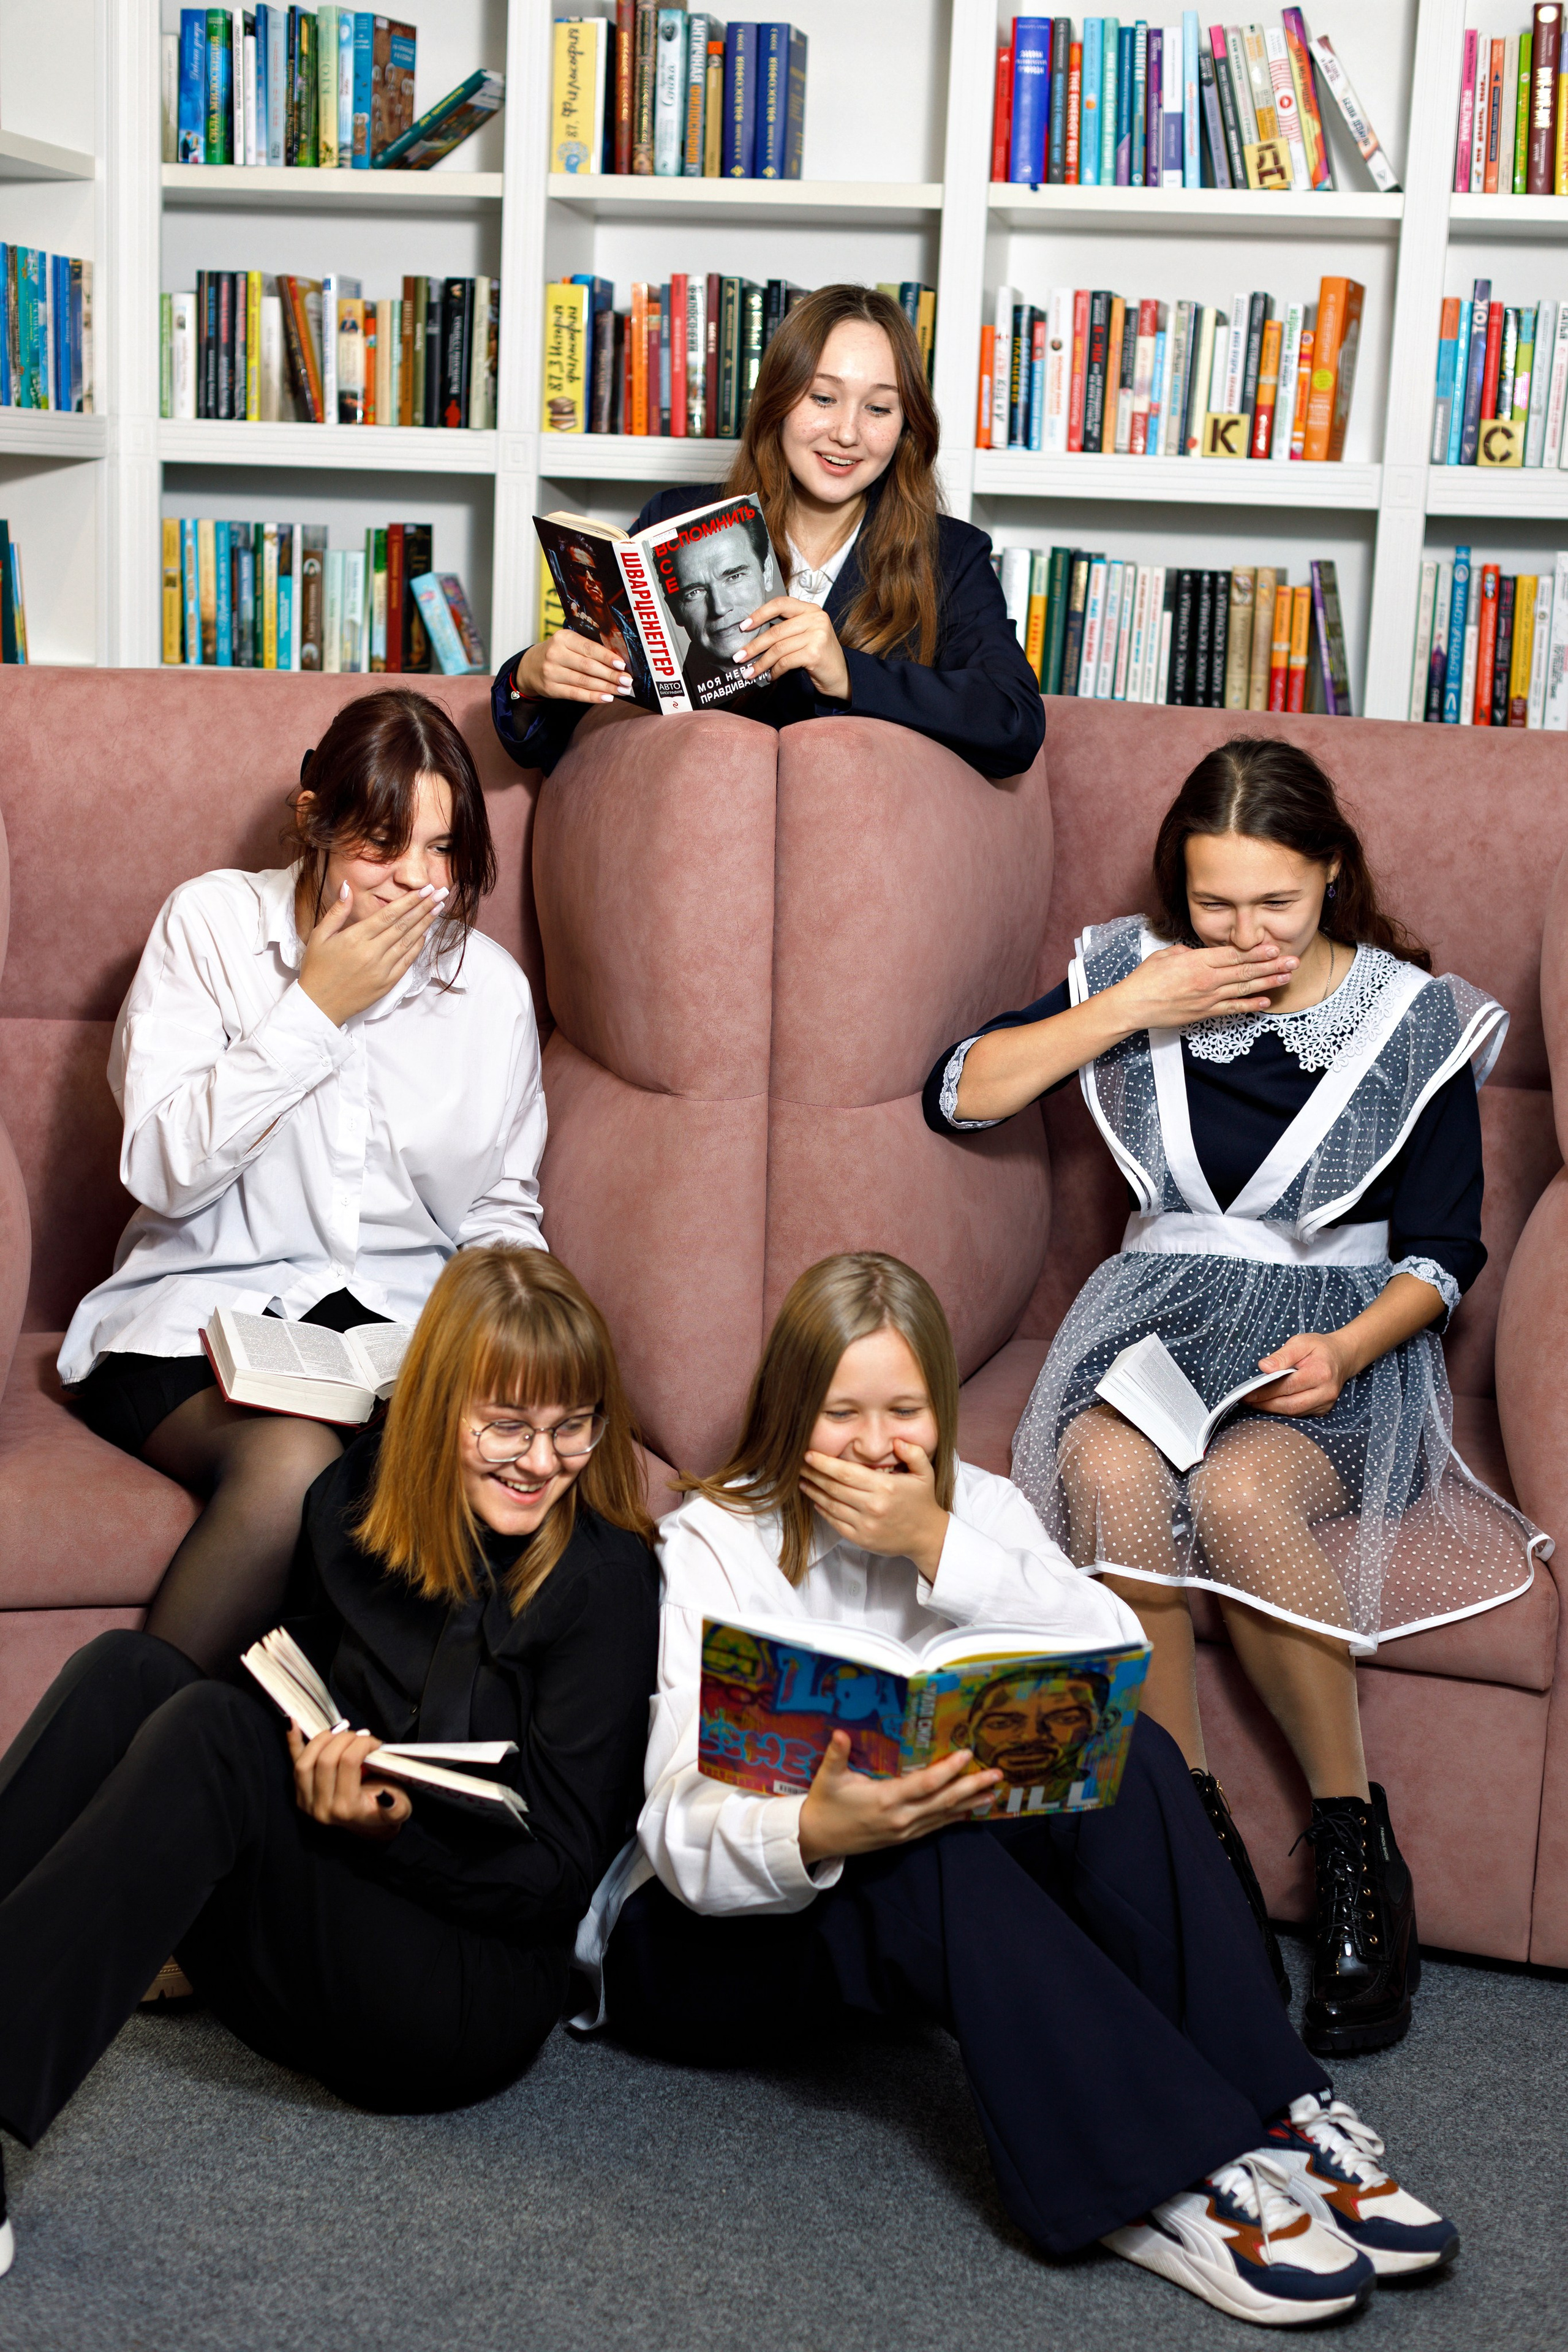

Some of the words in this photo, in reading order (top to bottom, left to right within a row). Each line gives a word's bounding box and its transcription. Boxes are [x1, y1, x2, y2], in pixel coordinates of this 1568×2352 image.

[689, 18, 706, 83] АНТИЧНАЯ
[734, 56, 745, 122] ФИЛОСОФИЯ
[766, 57, 778, 123] ФИЛОСОФИЯ
[1067, 70, 1080, 92] THE
[209, 113, 219, 143] СИЛА
[685, 85, 702, 163] ФИЛОСОФИЯ
[1067, 93, 1079, 138] ENERGY
[1067, 140, 1078, 164] BUS
[1472, 298, 1488, 336] ТОК
[1011, 337, 1022, 404] ПЛАЦЕБО
[1210, 418, 1241, 454] К
[1483, 426, 1513, 463] С
[654, 505, 755, 558] ВСПОМНИТЬ
[620, 552, 674, 676] ШВАРЦЕНЕГГЕР
[697, 676, 722, 693] МОЯ
